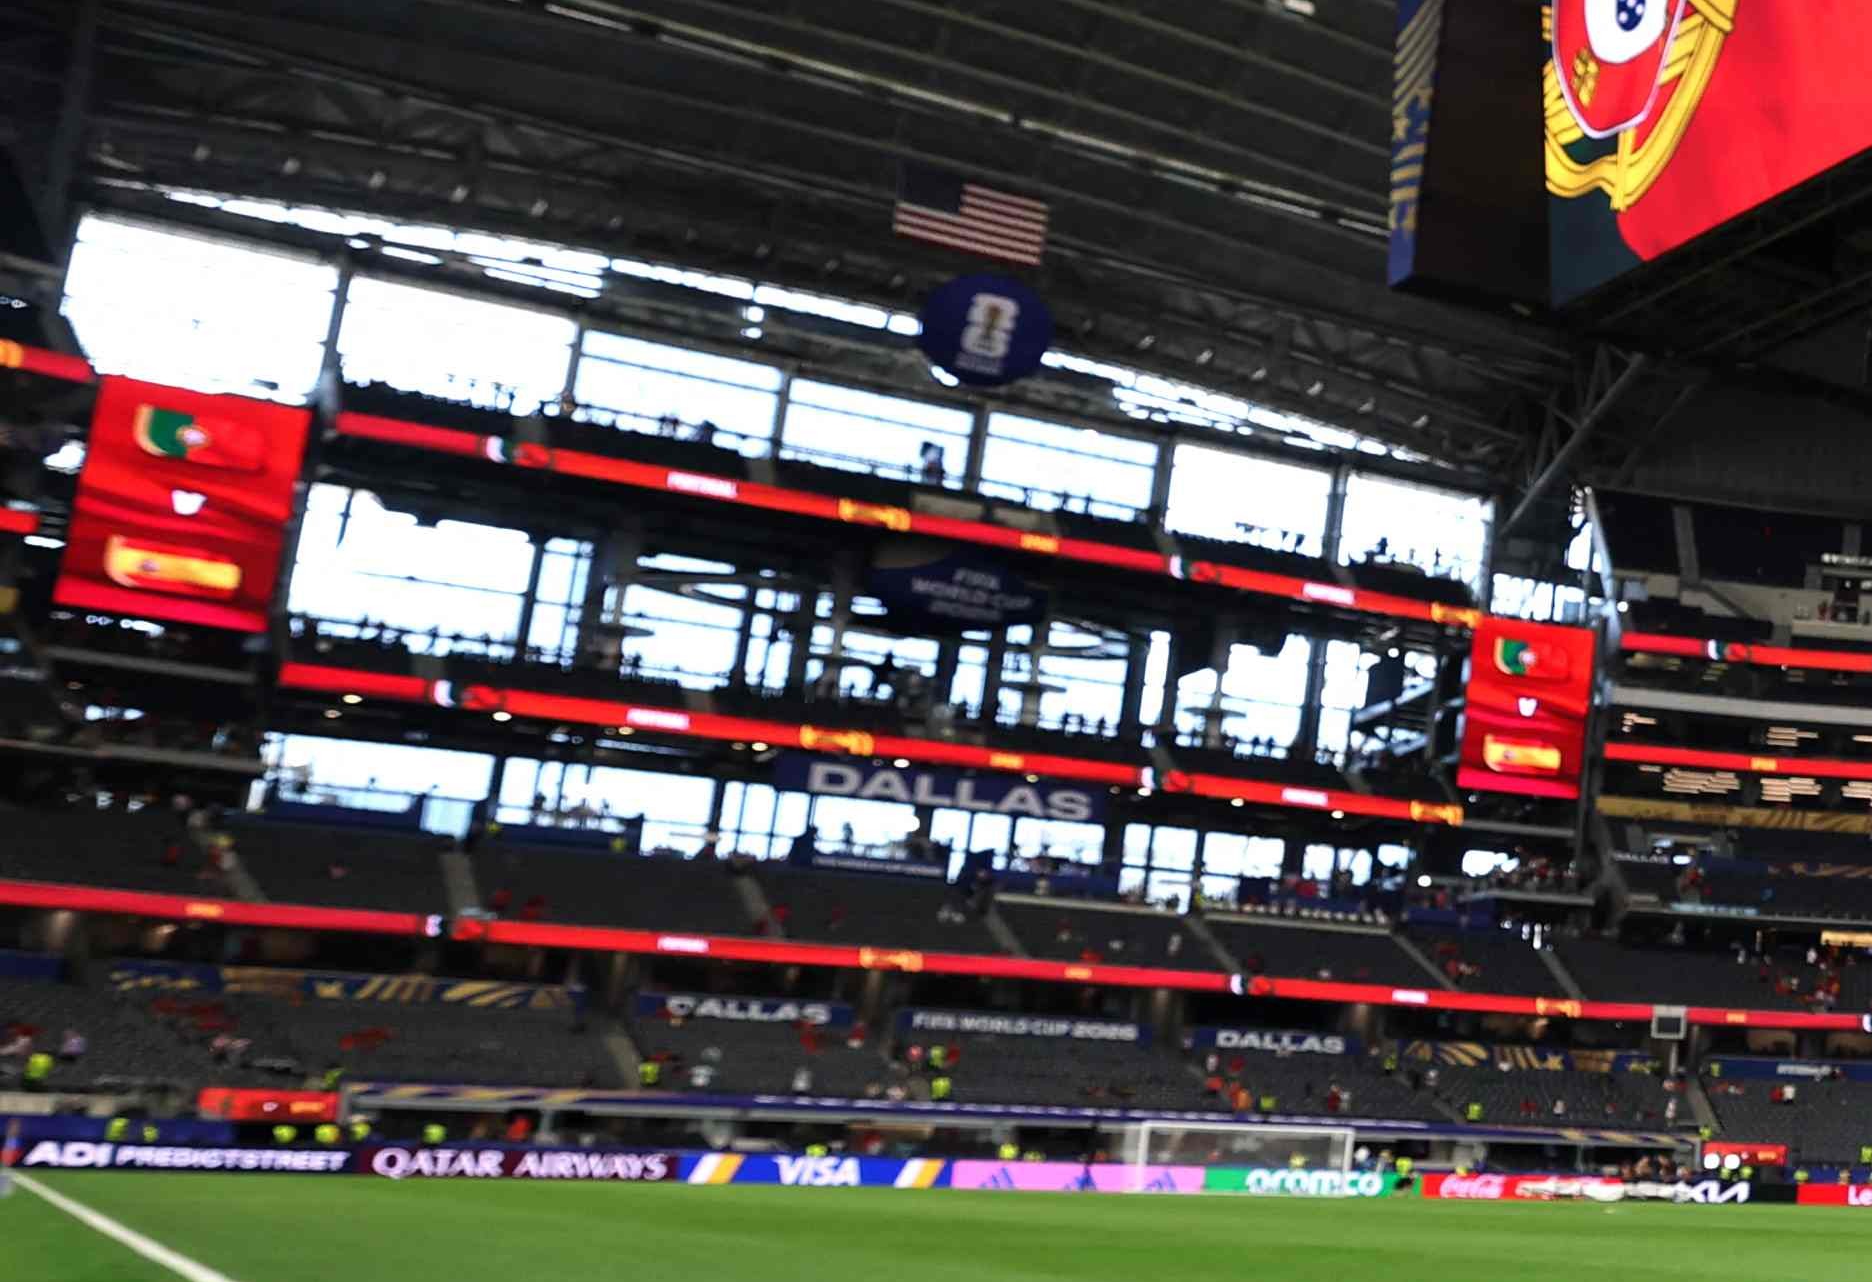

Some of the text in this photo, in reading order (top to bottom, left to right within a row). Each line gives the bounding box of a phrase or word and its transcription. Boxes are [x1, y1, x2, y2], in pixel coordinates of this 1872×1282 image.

[808, 763, 1093, 822] DALLAS
[667, 997, 831, 1024] DALLAS
[963, 1017, 1027, 1035] WORLD
[1031, 1019, 1071, 1038] CUP
[1073, 1023, 1138, 1041] 2026
[1216, 1030, 1345, 1055] DALLAS
[25, 1141, 350, 1173] ADI PREDICTSTREET
[373, 1148, 668, 1182] QATAR AIRWAYS
[773, 1156, 861, 1186] VISA
[1246, 1169, 1384, 1197] aramco
